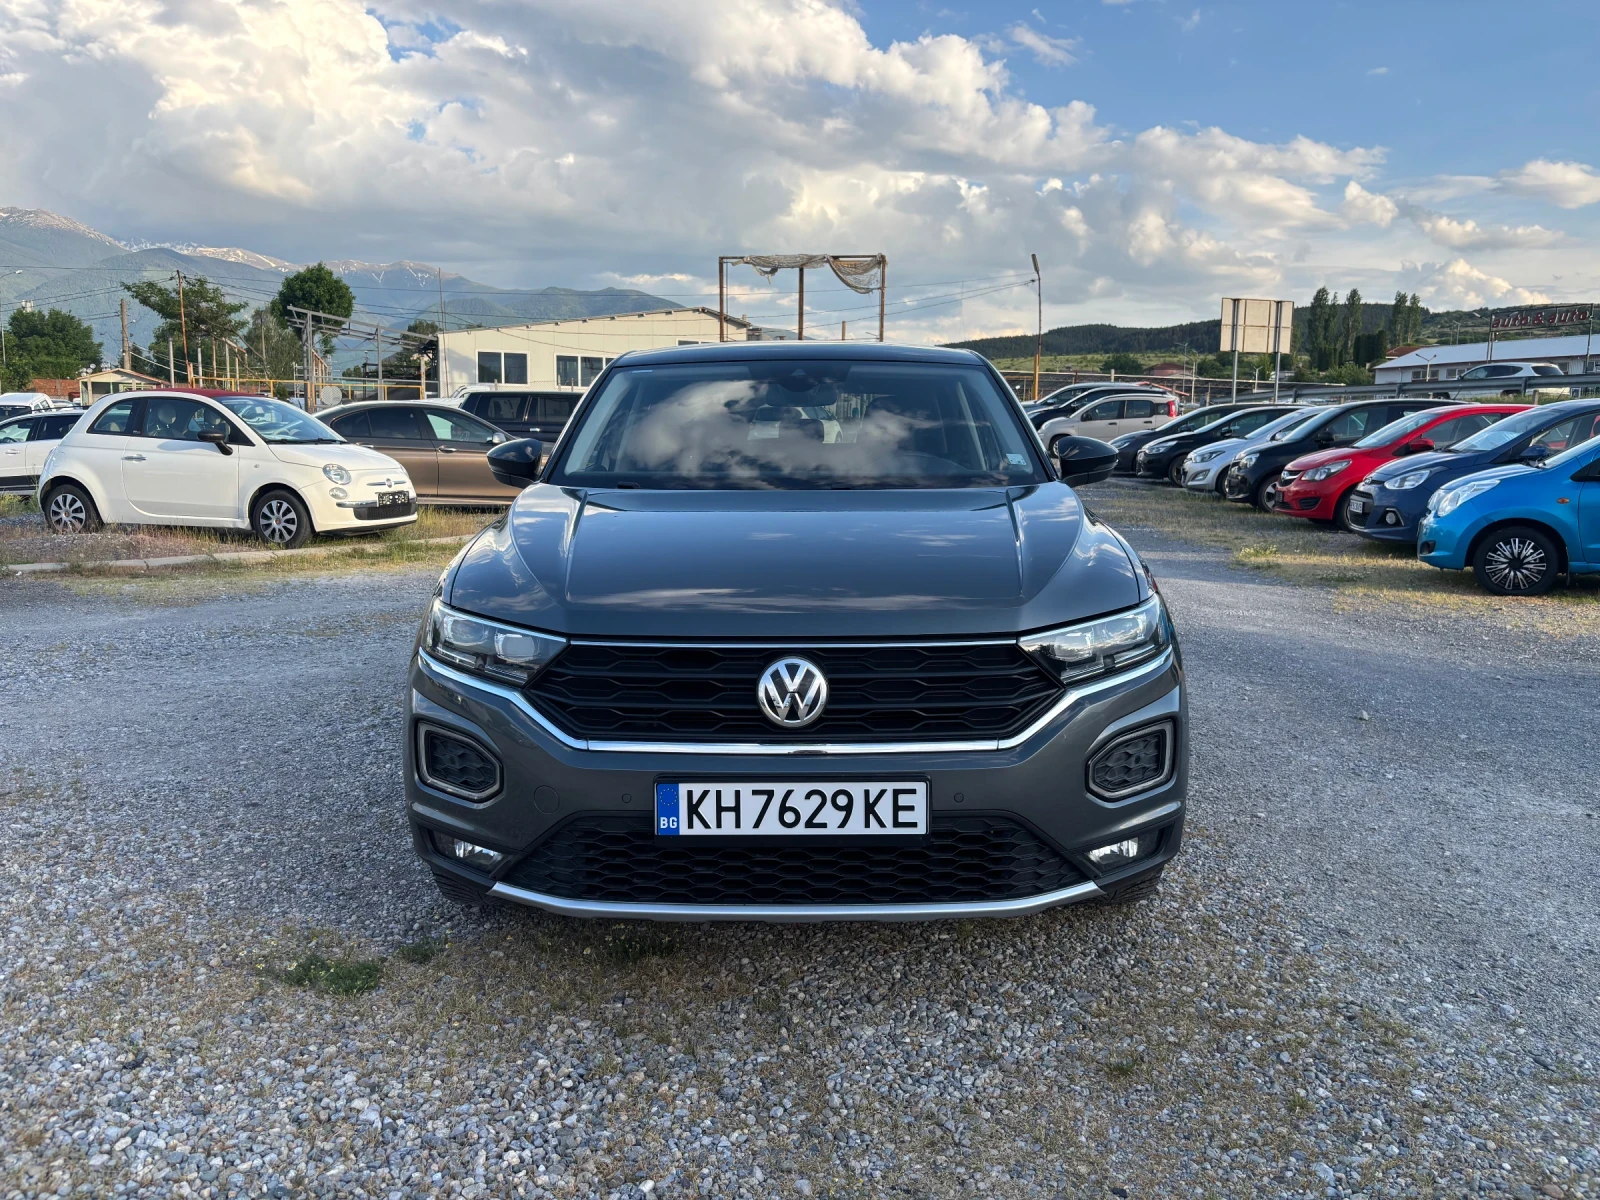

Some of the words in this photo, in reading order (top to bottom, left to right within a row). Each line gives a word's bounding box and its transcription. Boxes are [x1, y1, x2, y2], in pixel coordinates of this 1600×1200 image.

[1492, 314, 1530, 328] auto
[1532, 311, 1545, 325] &
[1548, 308, 1590, 324] auto
[660, 816, 678, 829] BG
